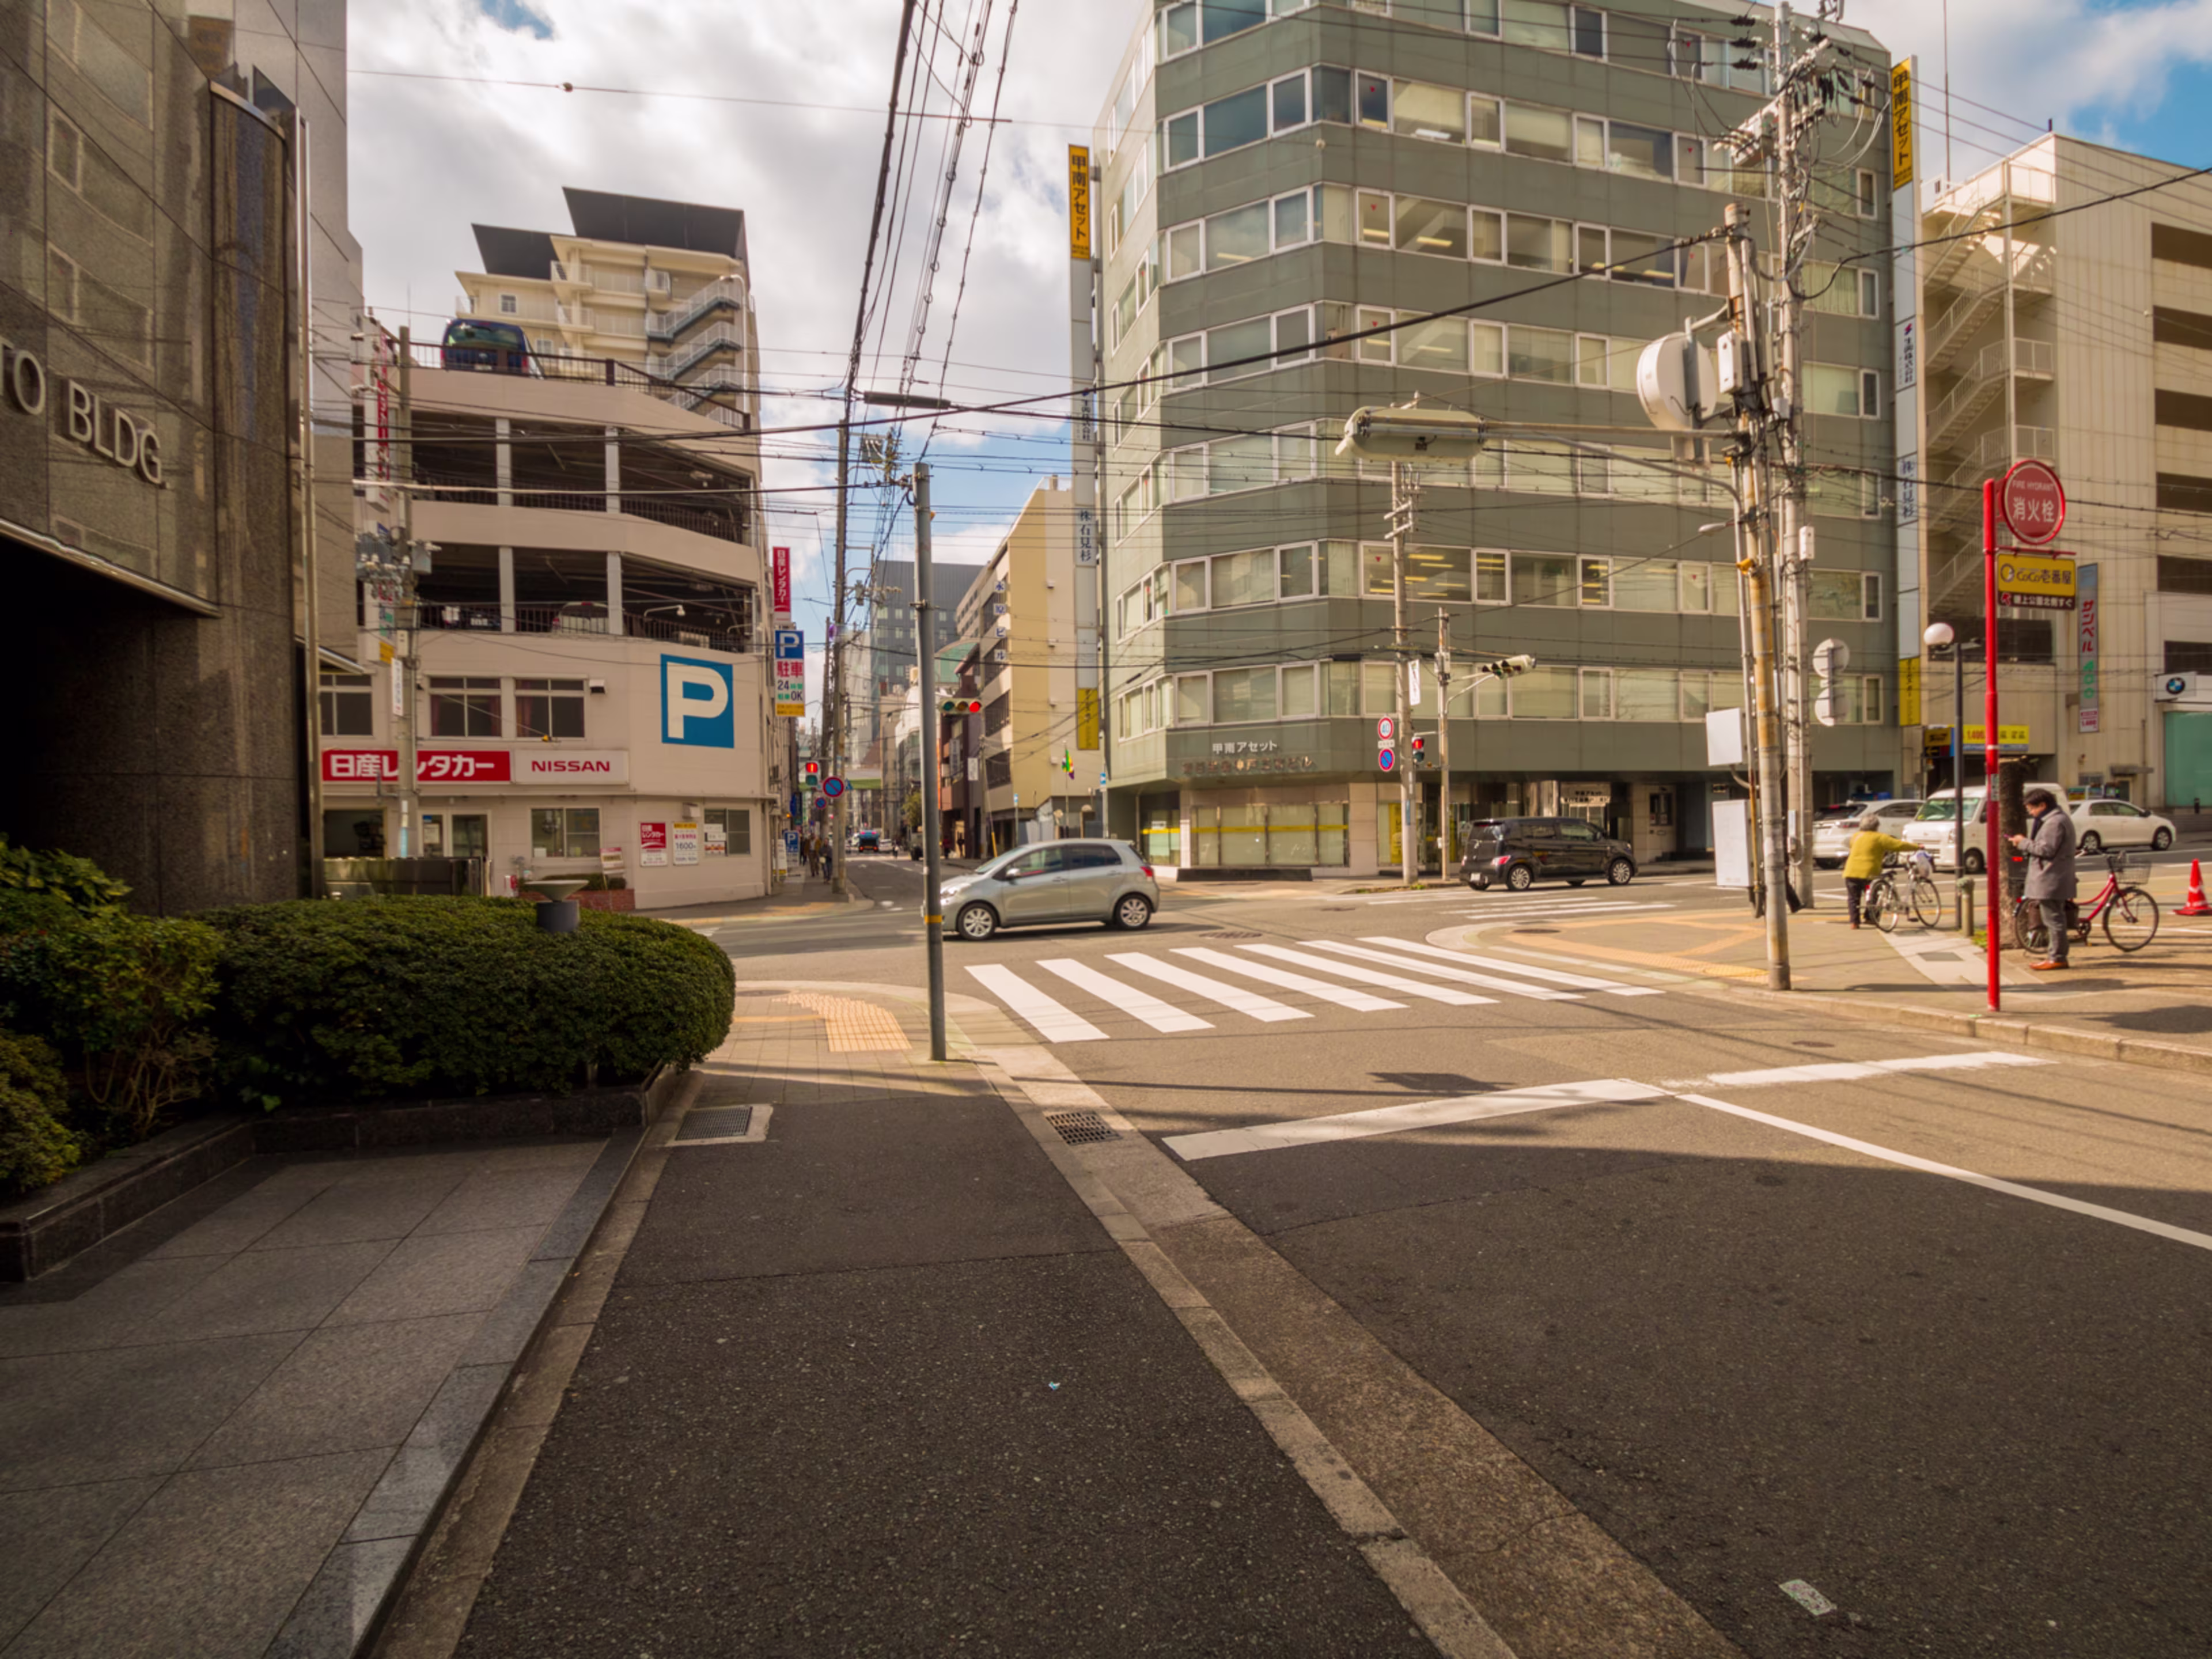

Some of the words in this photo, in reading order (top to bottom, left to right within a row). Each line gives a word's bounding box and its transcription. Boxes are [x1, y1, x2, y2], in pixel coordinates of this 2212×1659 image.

[1894, 70, 1909, 166] 甲南アセット
[1072, 155, 1086, 240] 甲南アセット
[2013, 497, 2055, 522] 消火栓
[779, 632, 800, 657] P
[777, 661, 803, 677] 駐車
[666, 661, 729, 739] P
[1212, 740, 1278, 755] 甲南アセット
[532, 761, 611, 772] NISSAN
